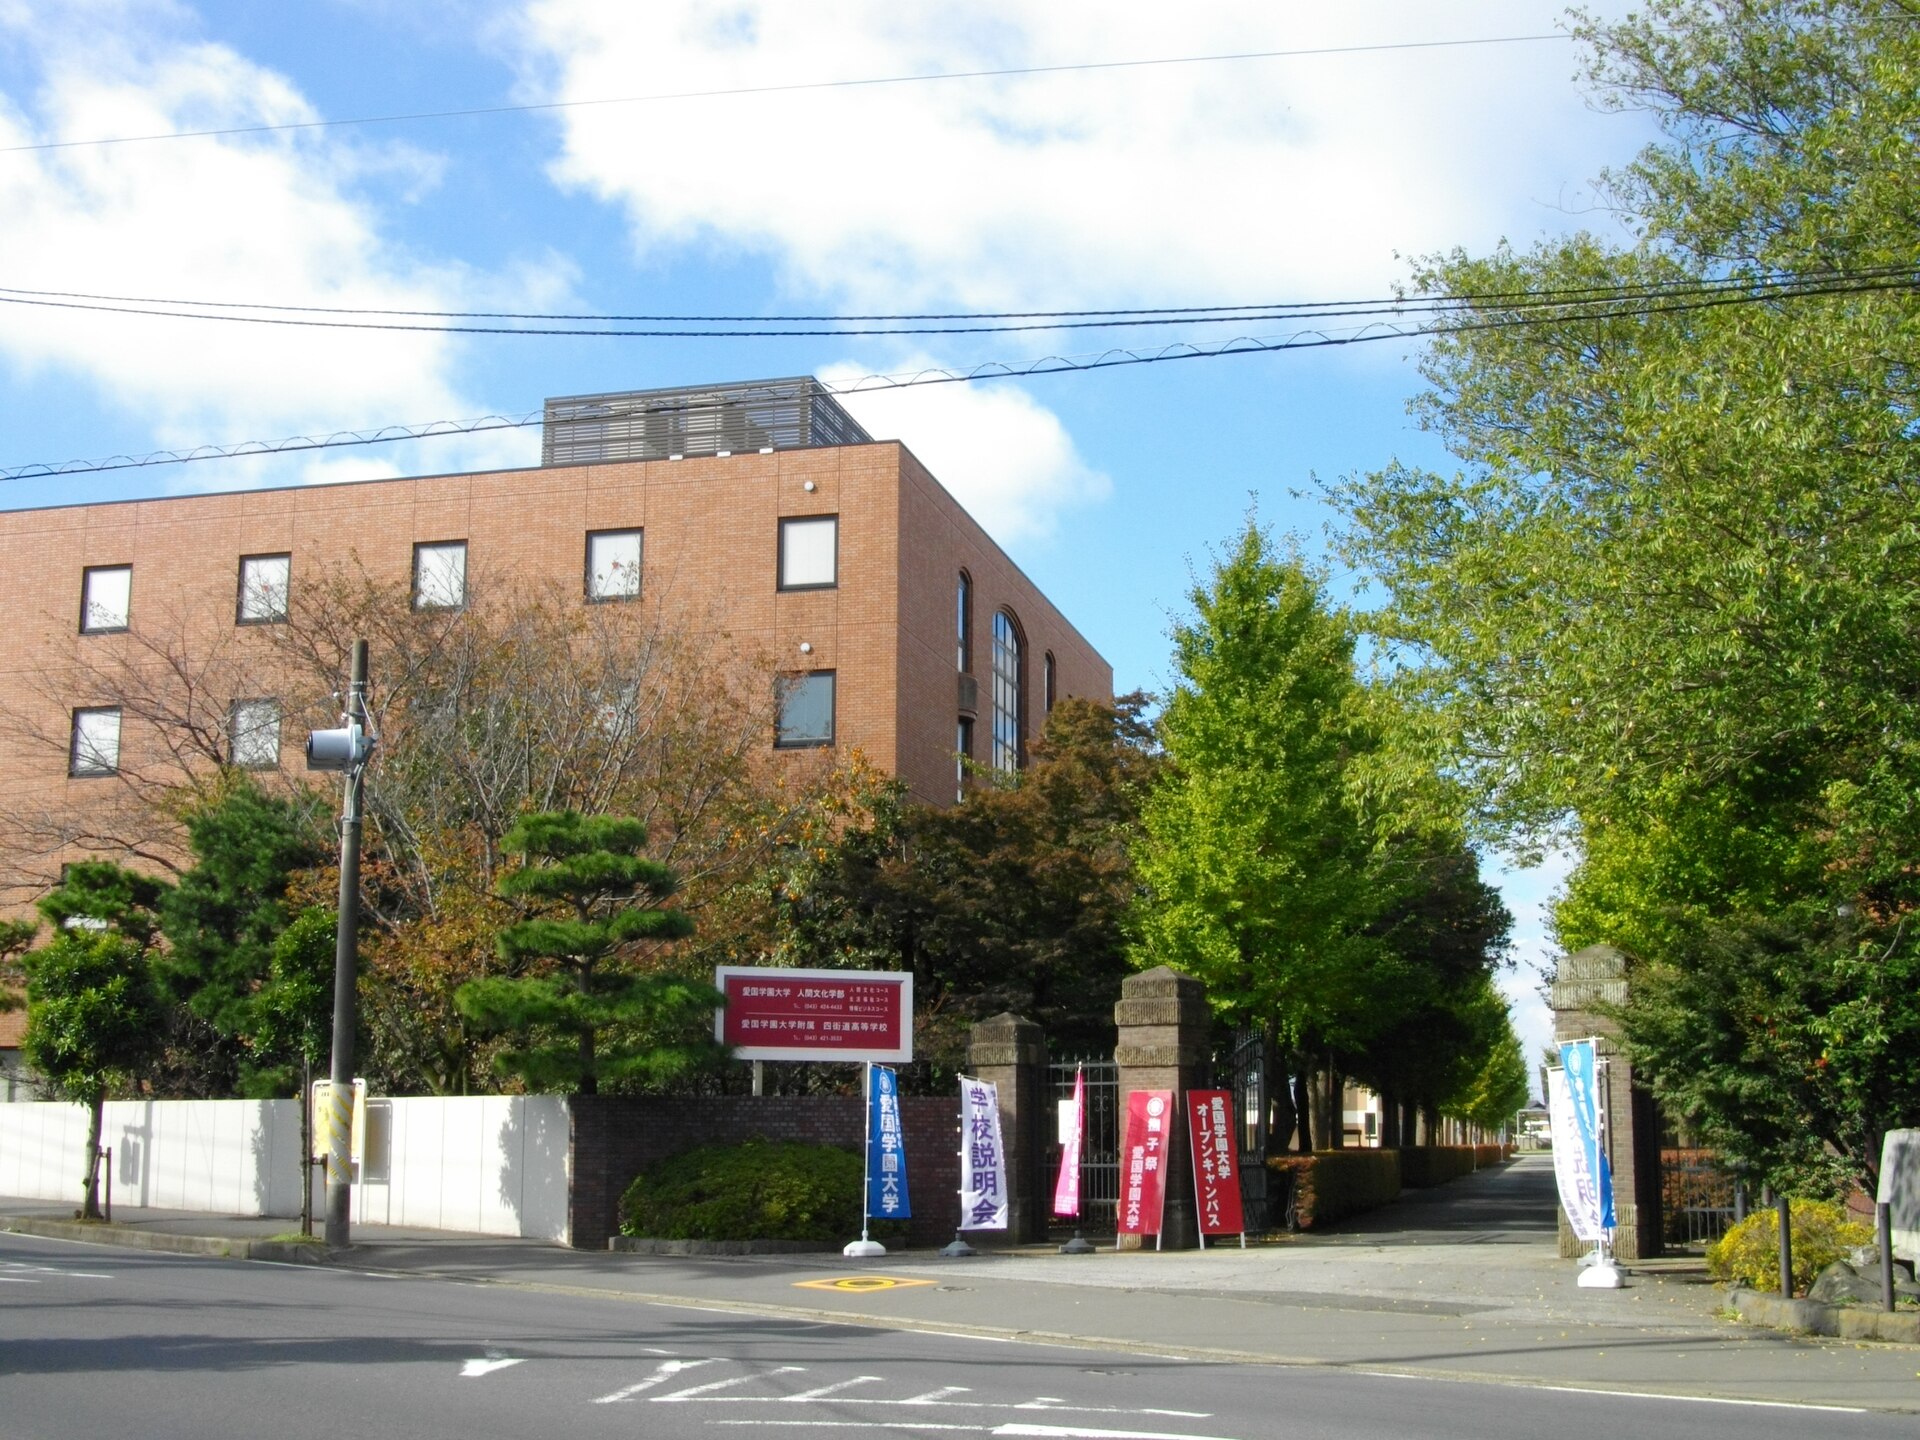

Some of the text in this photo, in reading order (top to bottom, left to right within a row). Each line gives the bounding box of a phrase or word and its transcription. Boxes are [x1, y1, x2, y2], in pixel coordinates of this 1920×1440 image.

[741, 1019, 888, 1032] 愛国学園大学附属 四街道高等学校
[742, 986, 845, 999] 愛国学園大学 人間文化学部
[880, 1094, 899, 1213] 愛国学園大学
[970, 1087, 999, 1225] 学校説明会
[1197, 1103, 1220, 1227] オープンキャンパス
[1211, 1097, 1231, 1179] 愛国学園大学
[1126, 1146, 1145, 1229] 愛国学園大学
